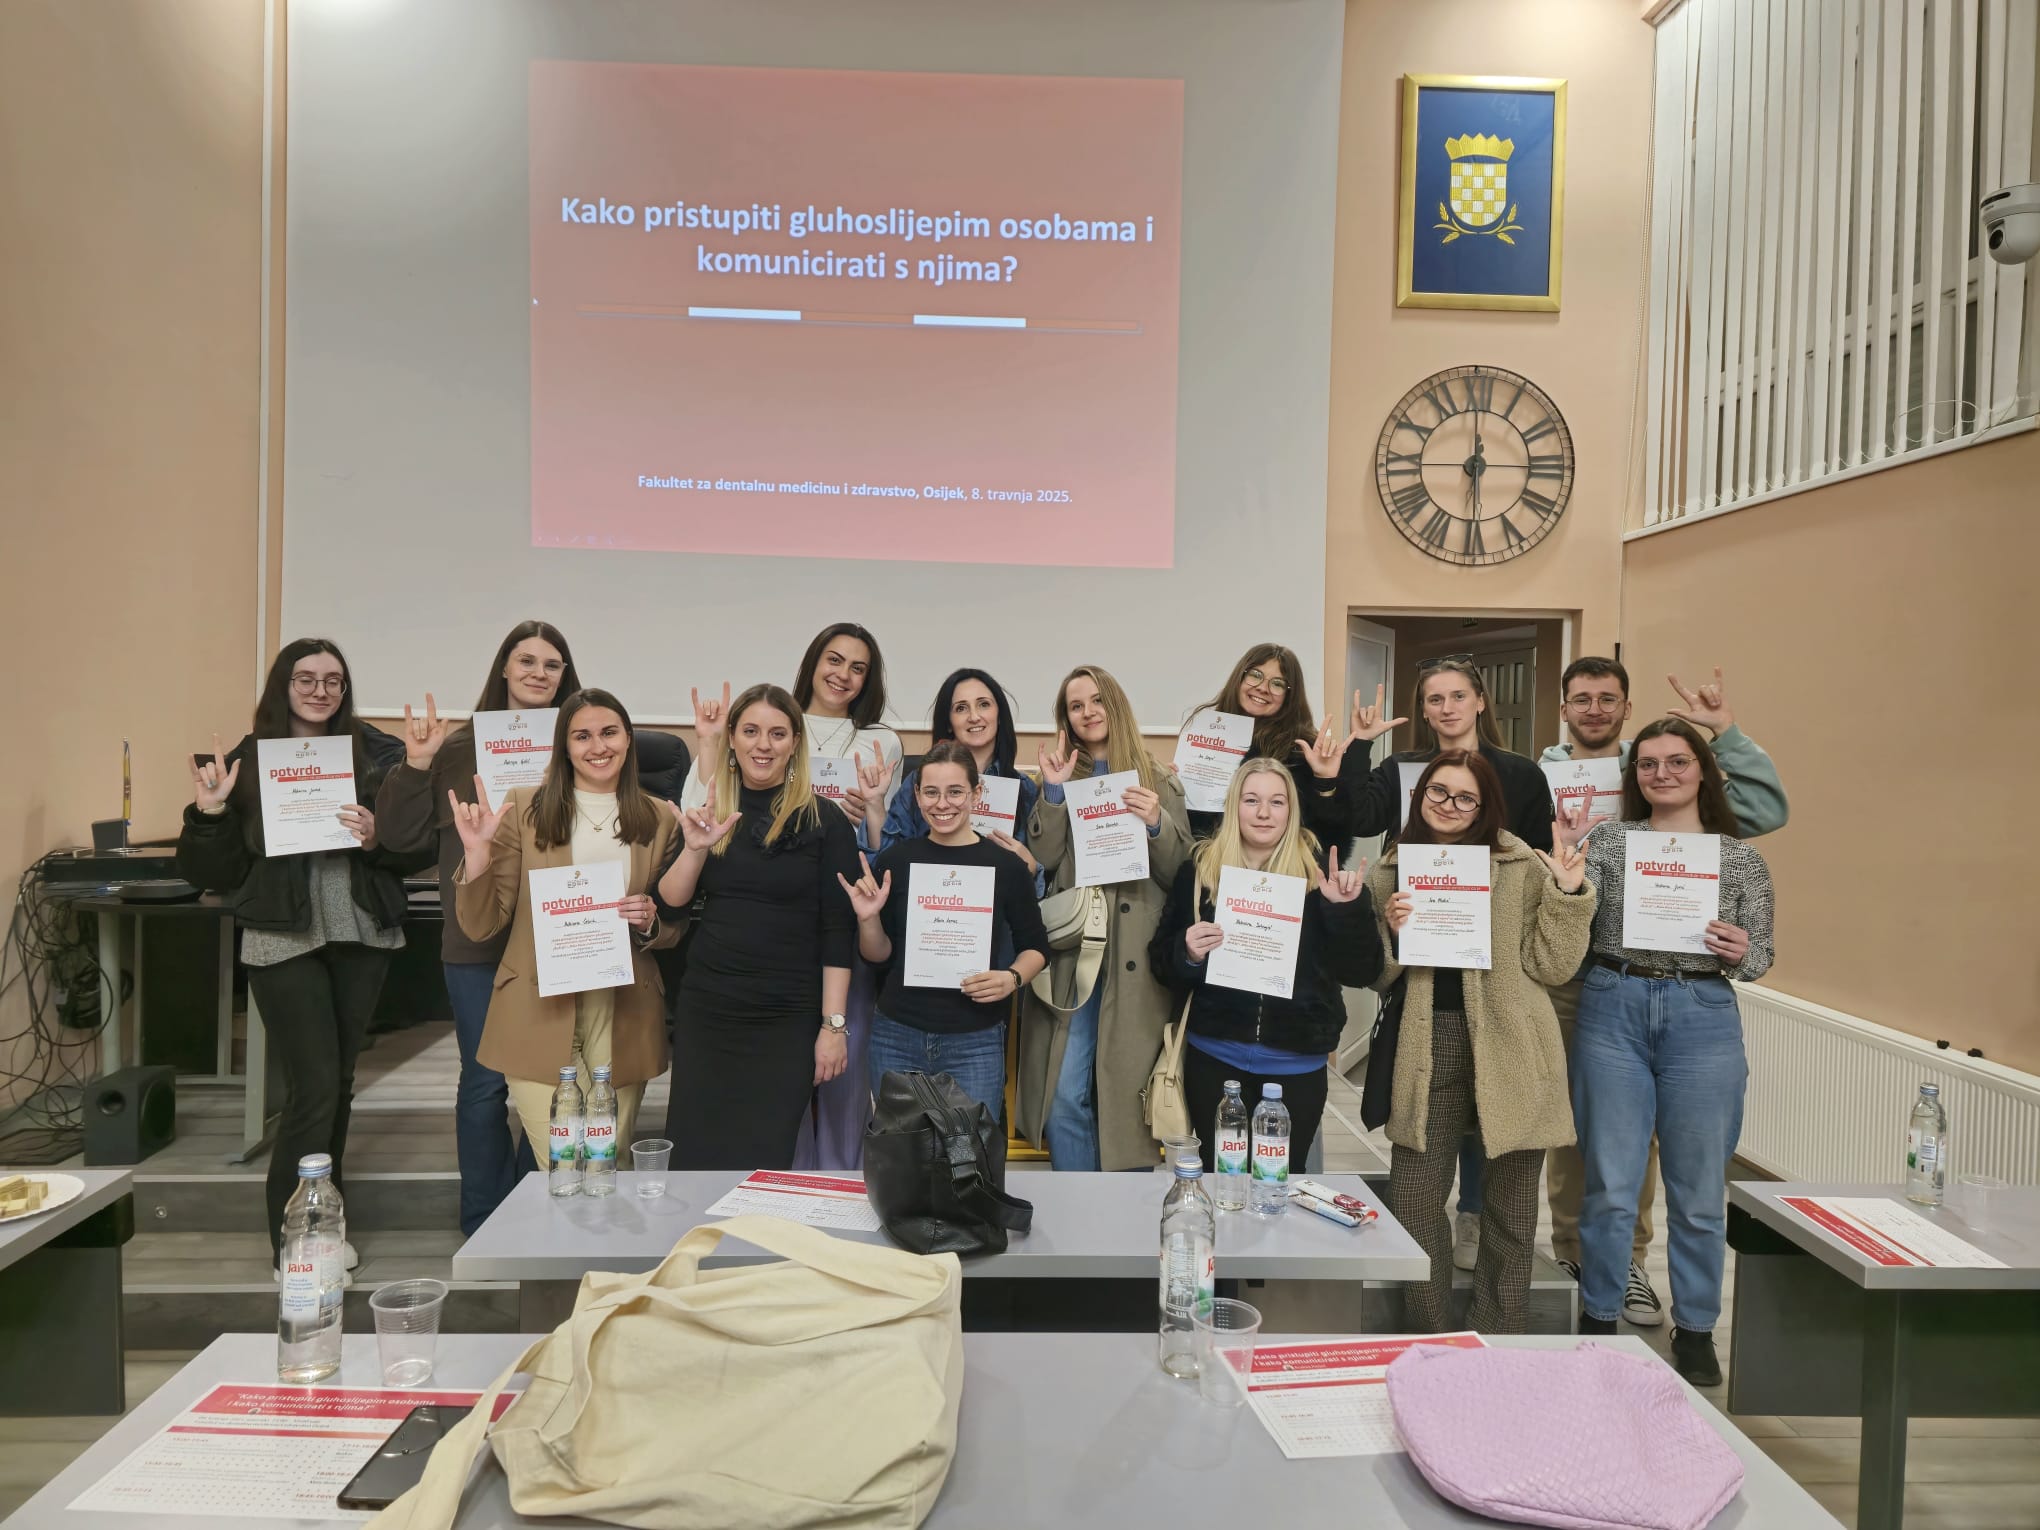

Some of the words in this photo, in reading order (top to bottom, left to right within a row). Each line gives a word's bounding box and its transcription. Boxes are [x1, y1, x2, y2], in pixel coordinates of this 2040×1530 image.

[561, 197, 635, 225] Kako
[644, 200, 781, 235] pristupiti
[789, 204, 990, 242] gluhoslijepim
[999, 212, 1136, 242] osobama
[1146, 215, 1154, 241] i
[697, 244, 885, 278] komunicirati
[894, 258, 909, 279] s
[918, 253, 1018, 286] njima?
[638, 475, 694, 489] Fakultet
[697, 478, 711, 490] za
[715, 478, 775, 492] dentalnu
[779, 480, 840, 495] medicinu
[844, 483, 849, 495] i
[851, 483, 920, 500] zdravstvo,
[923, 485, 968, 501] Osijek,
[971, 487, 984, 500] 8.
[987, 488, 1033, 504] travnja
[1037, 489, 1073, 503] 2025.
[485, 736, 532, 751] potvrda
[1186, 733, 1226, 747] potvrda
[270, 764, 321, 779] potvrda
[811, 783, 840, 794] tvrda
[1076, 801, 1117, 817] potvrda
[1635, 860, 1686, 872] potvrda
[1408, 874, 1457, 886] potvrda
[542, 894, 593, 912] potvrda
[917, 894, 964, 906] potvrda
[1225, 896, 1273, 912] potvrda
[549, 1125, 570, 1137] ana
[586, 1125, 612, 1138] Jana
[1222, 1140, 1247, 1152] Jana
[1256, 1143, 1286, 1157] Jana
[288, 1263, 314, 1274] Jana
